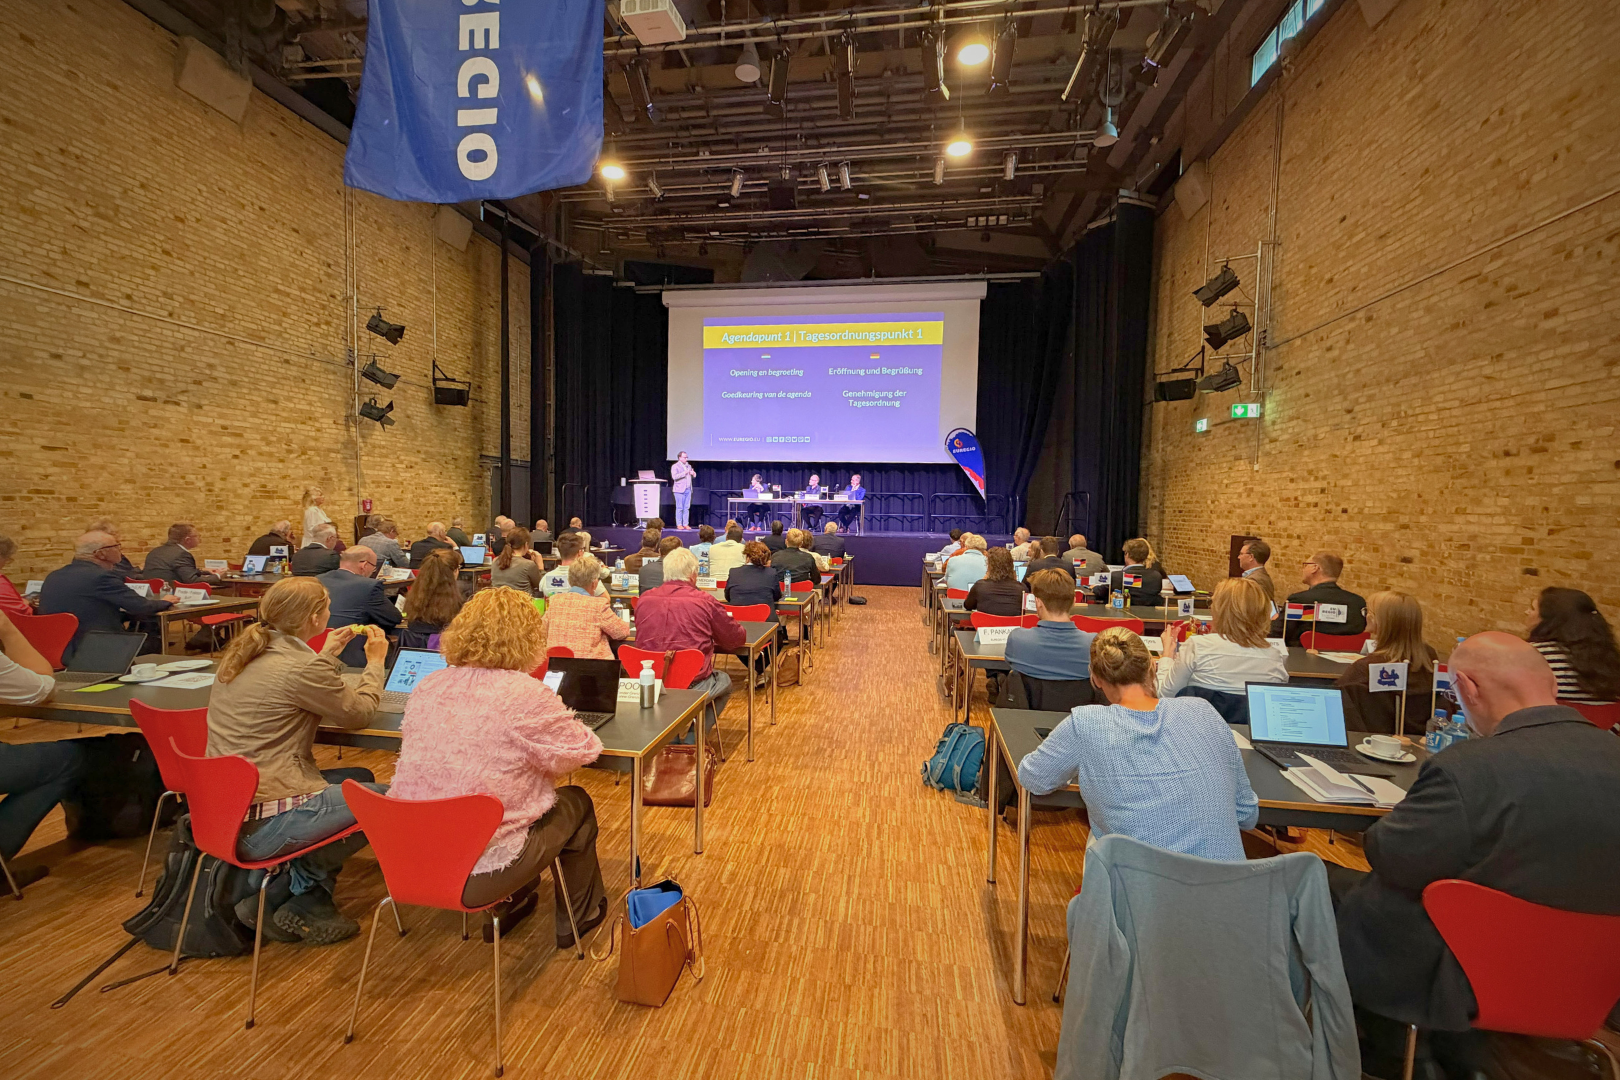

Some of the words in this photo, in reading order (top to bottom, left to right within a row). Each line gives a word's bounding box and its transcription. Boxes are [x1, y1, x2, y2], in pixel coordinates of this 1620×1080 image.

[457, 0, 500, 181] EGIO
[721, 331, 783, 344] Agendapunt
[785, 331, 791, 341] 1
[799, 328, 913, 343] Tagesordnungspunkt
[917, 328, 923, 339] 1
[730, 369, 758, 377] Opening
[768, 368, 804, 377] begroeting
[828, 367, 865, 376] Eröffnung
[866, 367, 880, 375] und
[881, 366, 923, 375] Begrüßung
[721, 391, 763, 399] Goedkeuring
[787, 390, 812, 399] agenda
[842, 390, 893, 398] Genehmigung
[848, 399, 900, 408] Tagesordnung
[990, 628, 1012, 636] PANKA
